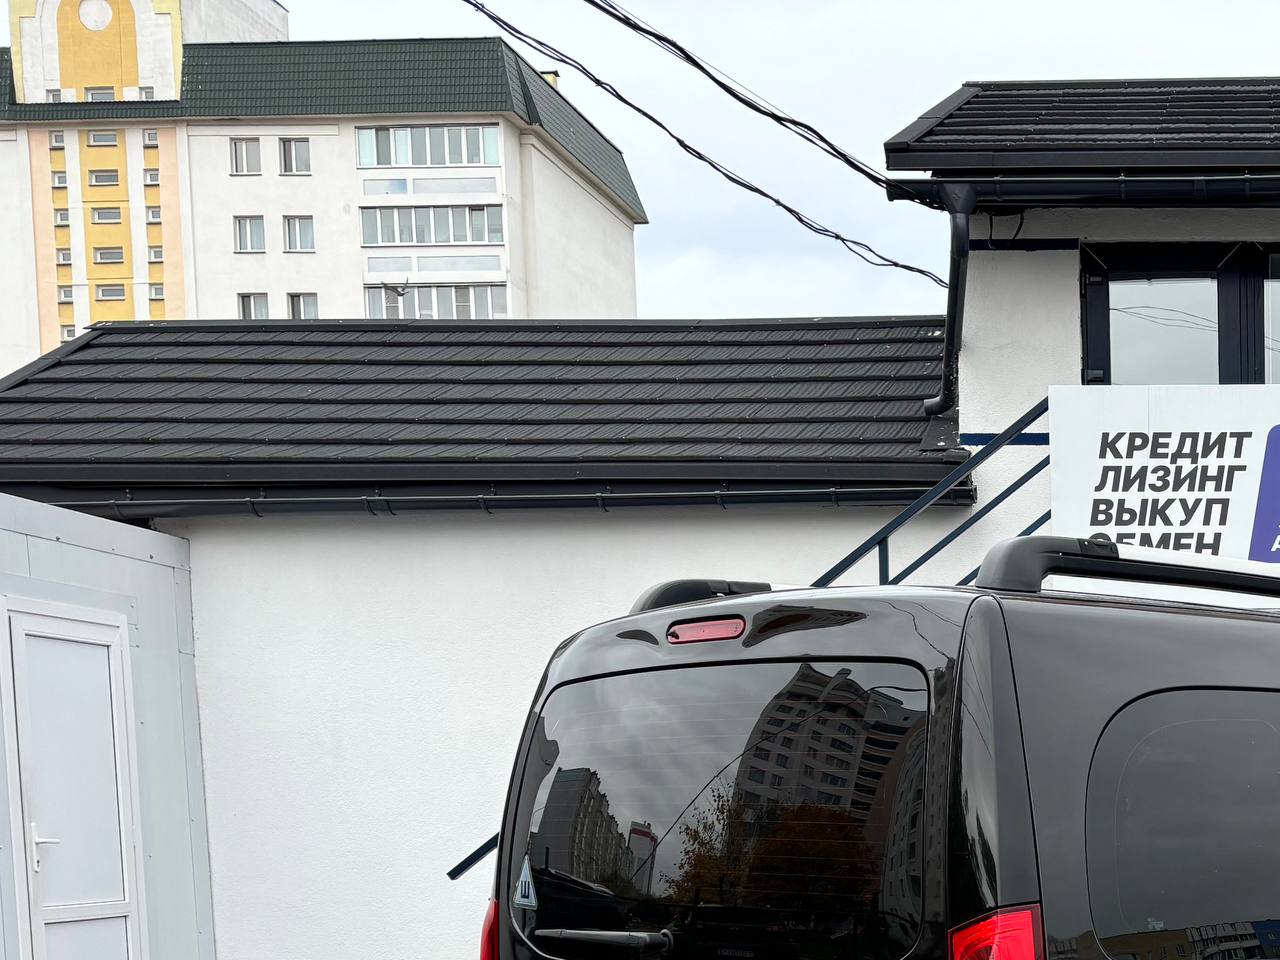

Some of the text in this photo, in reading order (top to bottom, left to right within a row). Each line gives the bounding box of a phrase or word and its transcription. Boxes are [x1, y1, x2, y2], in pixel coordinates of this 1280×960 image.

[1099, 431, 1253, 465] КРЕДИТ
[1094, 465, 1248, 493] ЛИЗИНГ
[1089, 498, 1231, 527] ВЫКУП
[520, 880, 530, 899] Ш
